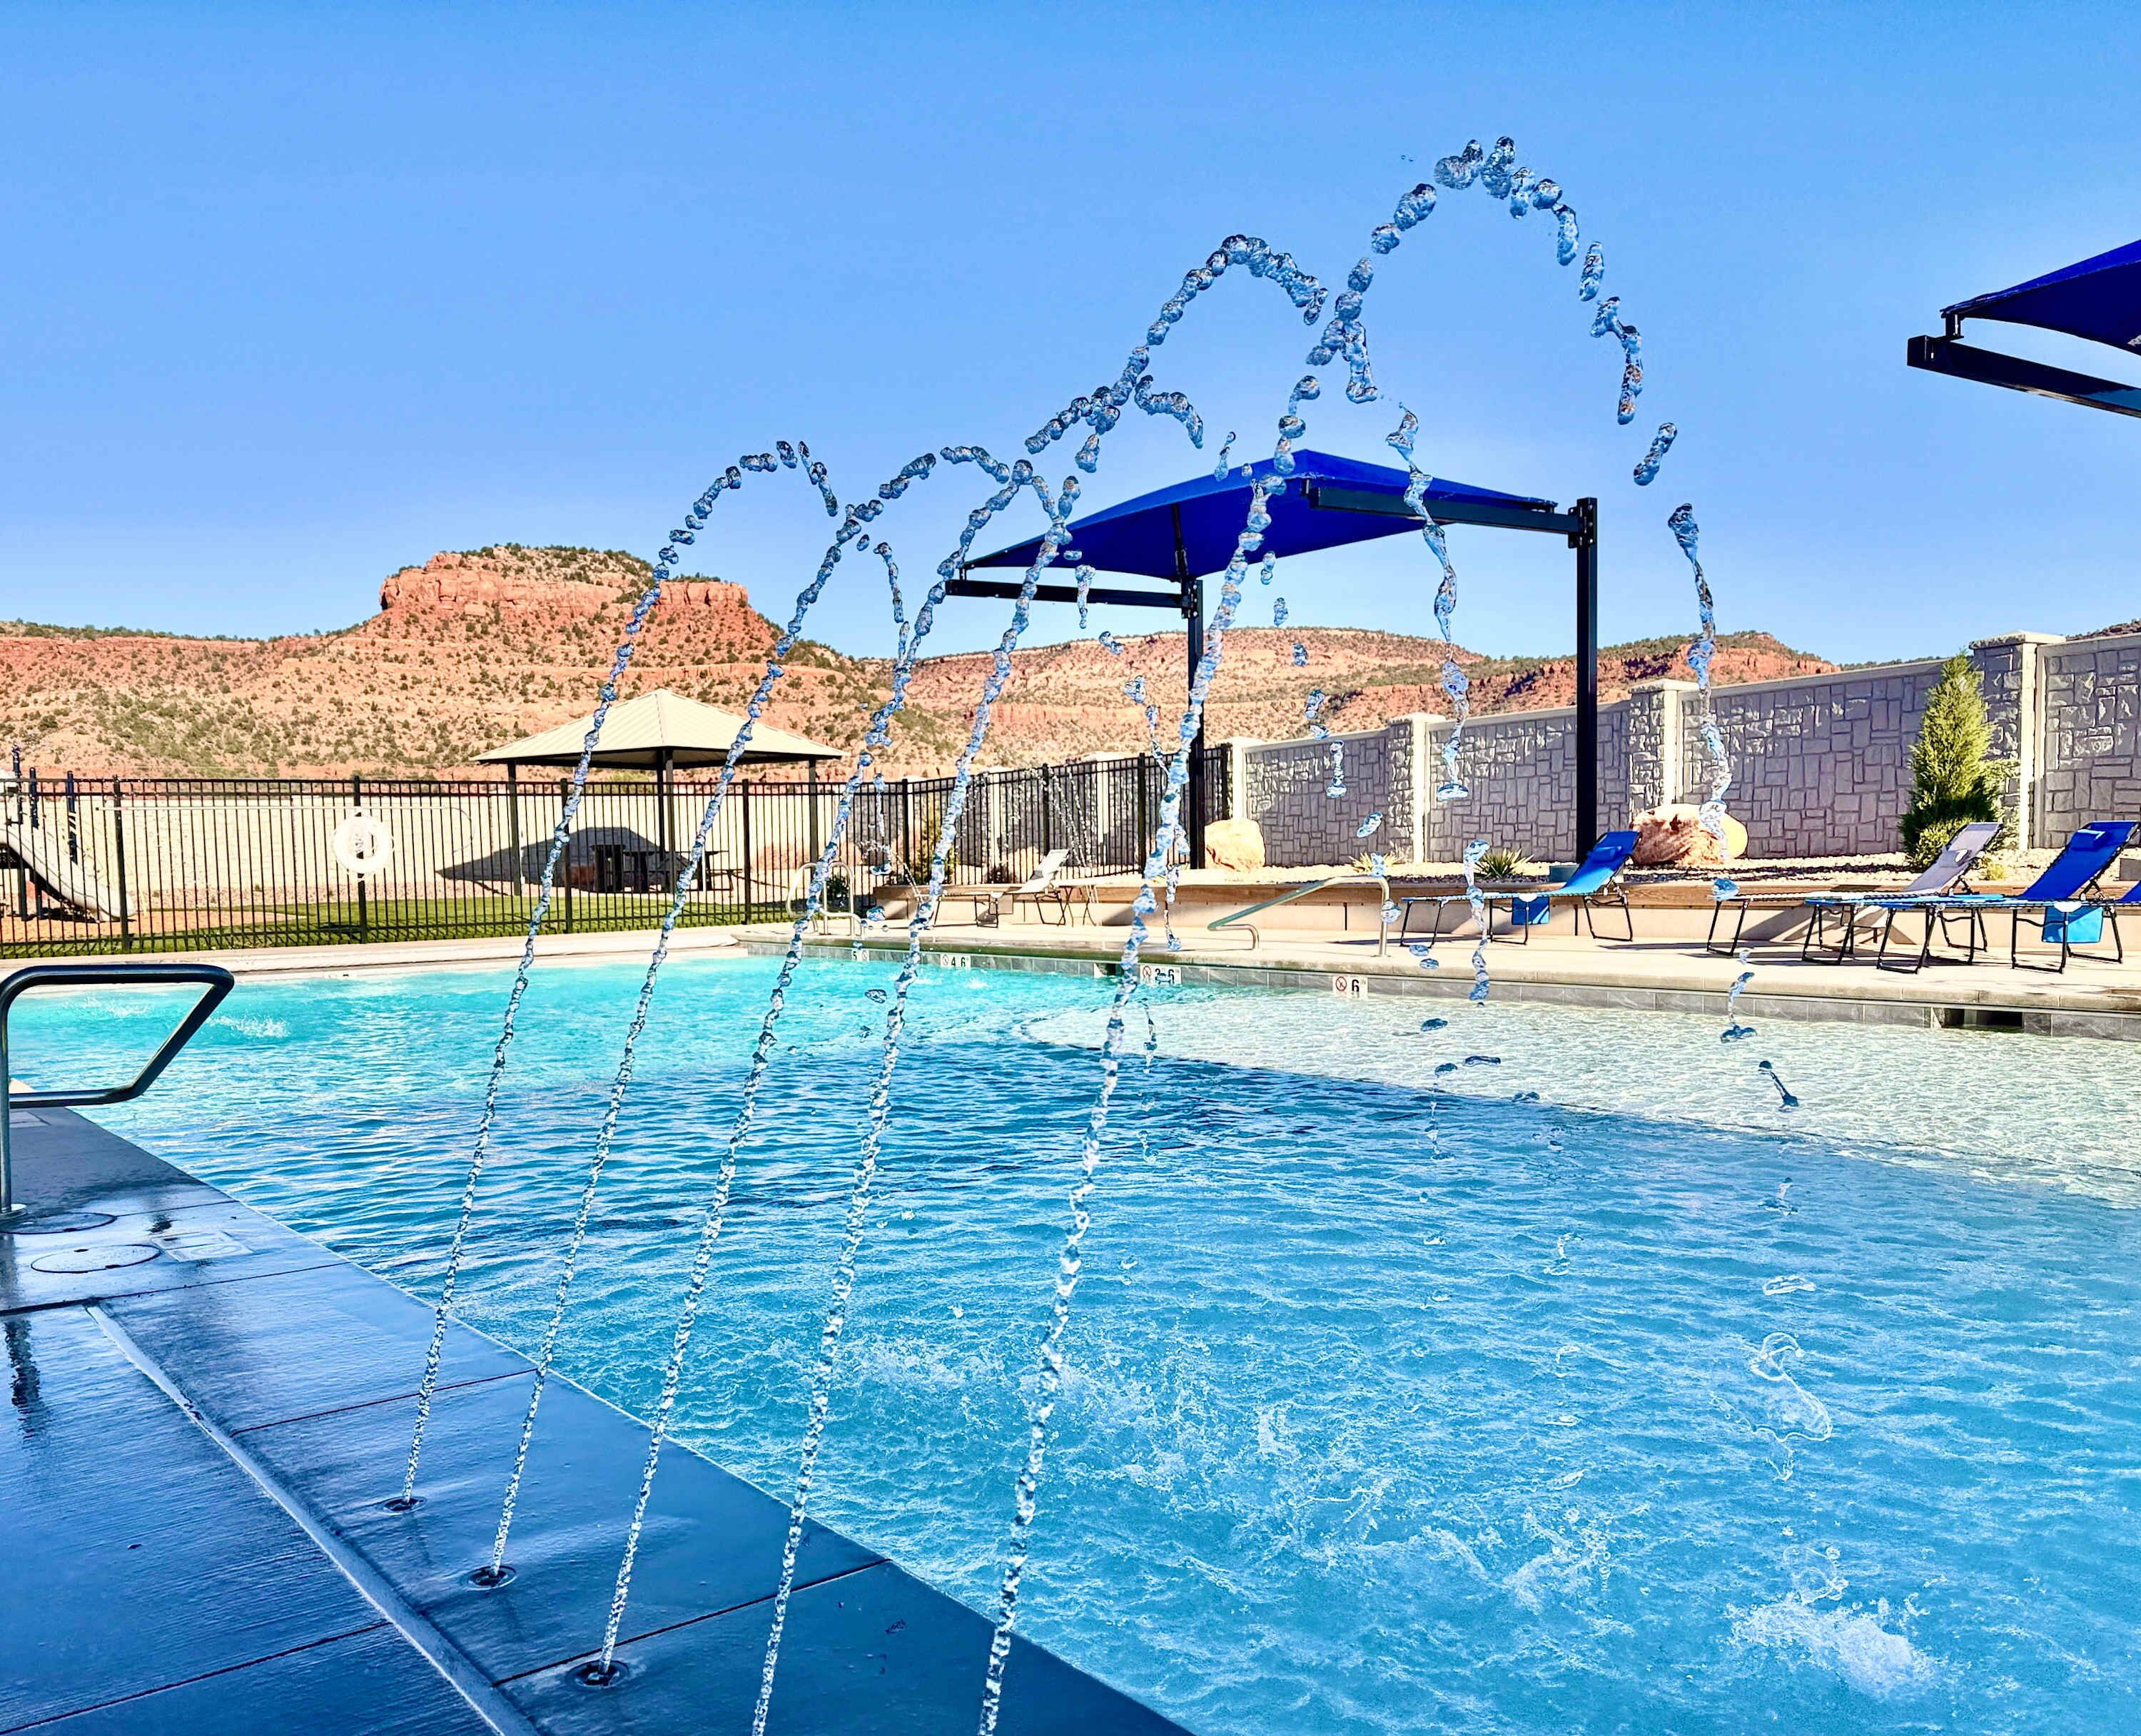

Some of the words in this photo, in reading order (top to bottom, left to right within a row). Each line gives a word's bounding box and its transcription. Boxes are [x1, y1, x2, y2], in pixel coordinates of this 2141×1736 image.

[951, 957, 956, 967] 4
[961, 957, 966, 968] 6
[1352, 979, 1360, 993] 6
